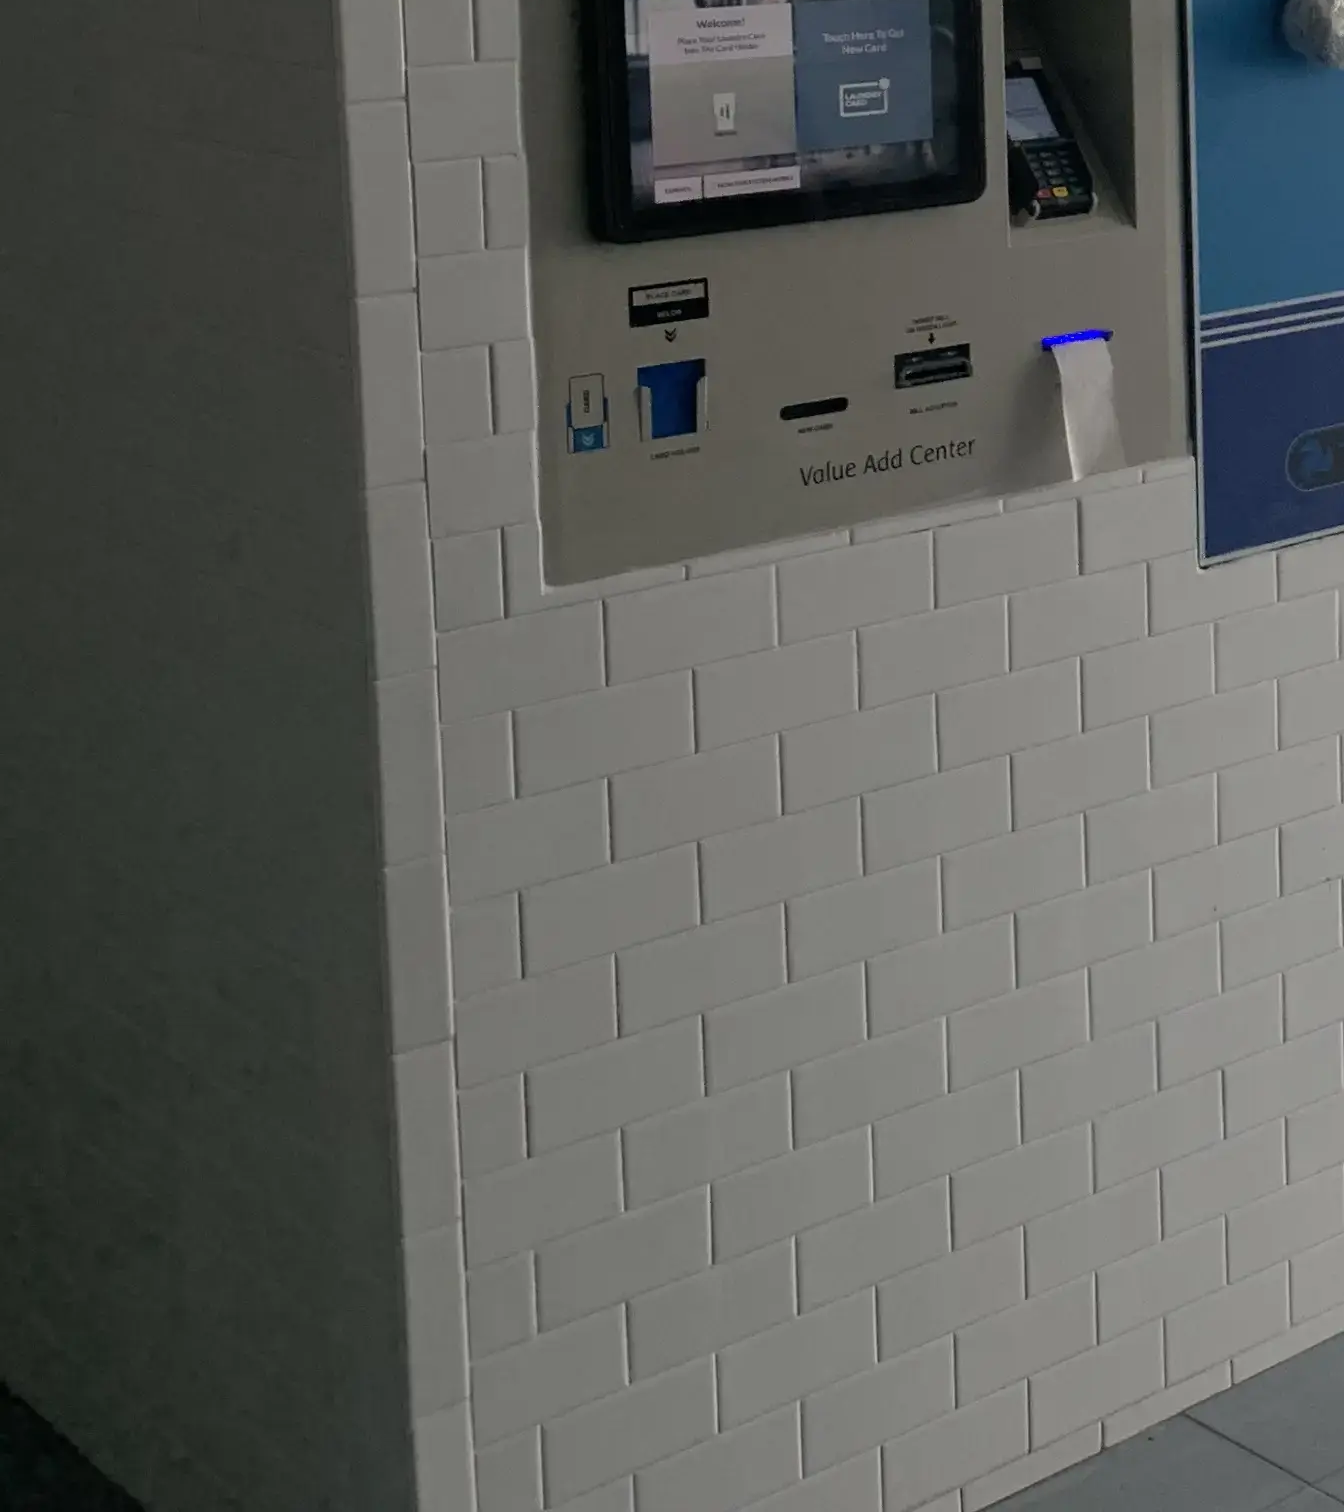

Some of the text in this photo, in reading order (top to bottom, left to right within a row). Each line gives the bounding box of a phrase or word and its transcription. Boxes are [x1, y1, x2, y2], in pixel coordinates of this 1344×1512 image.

[696, 17, 746, 30] Welcome!
[799, 437, 976, 487] Value Add Center
